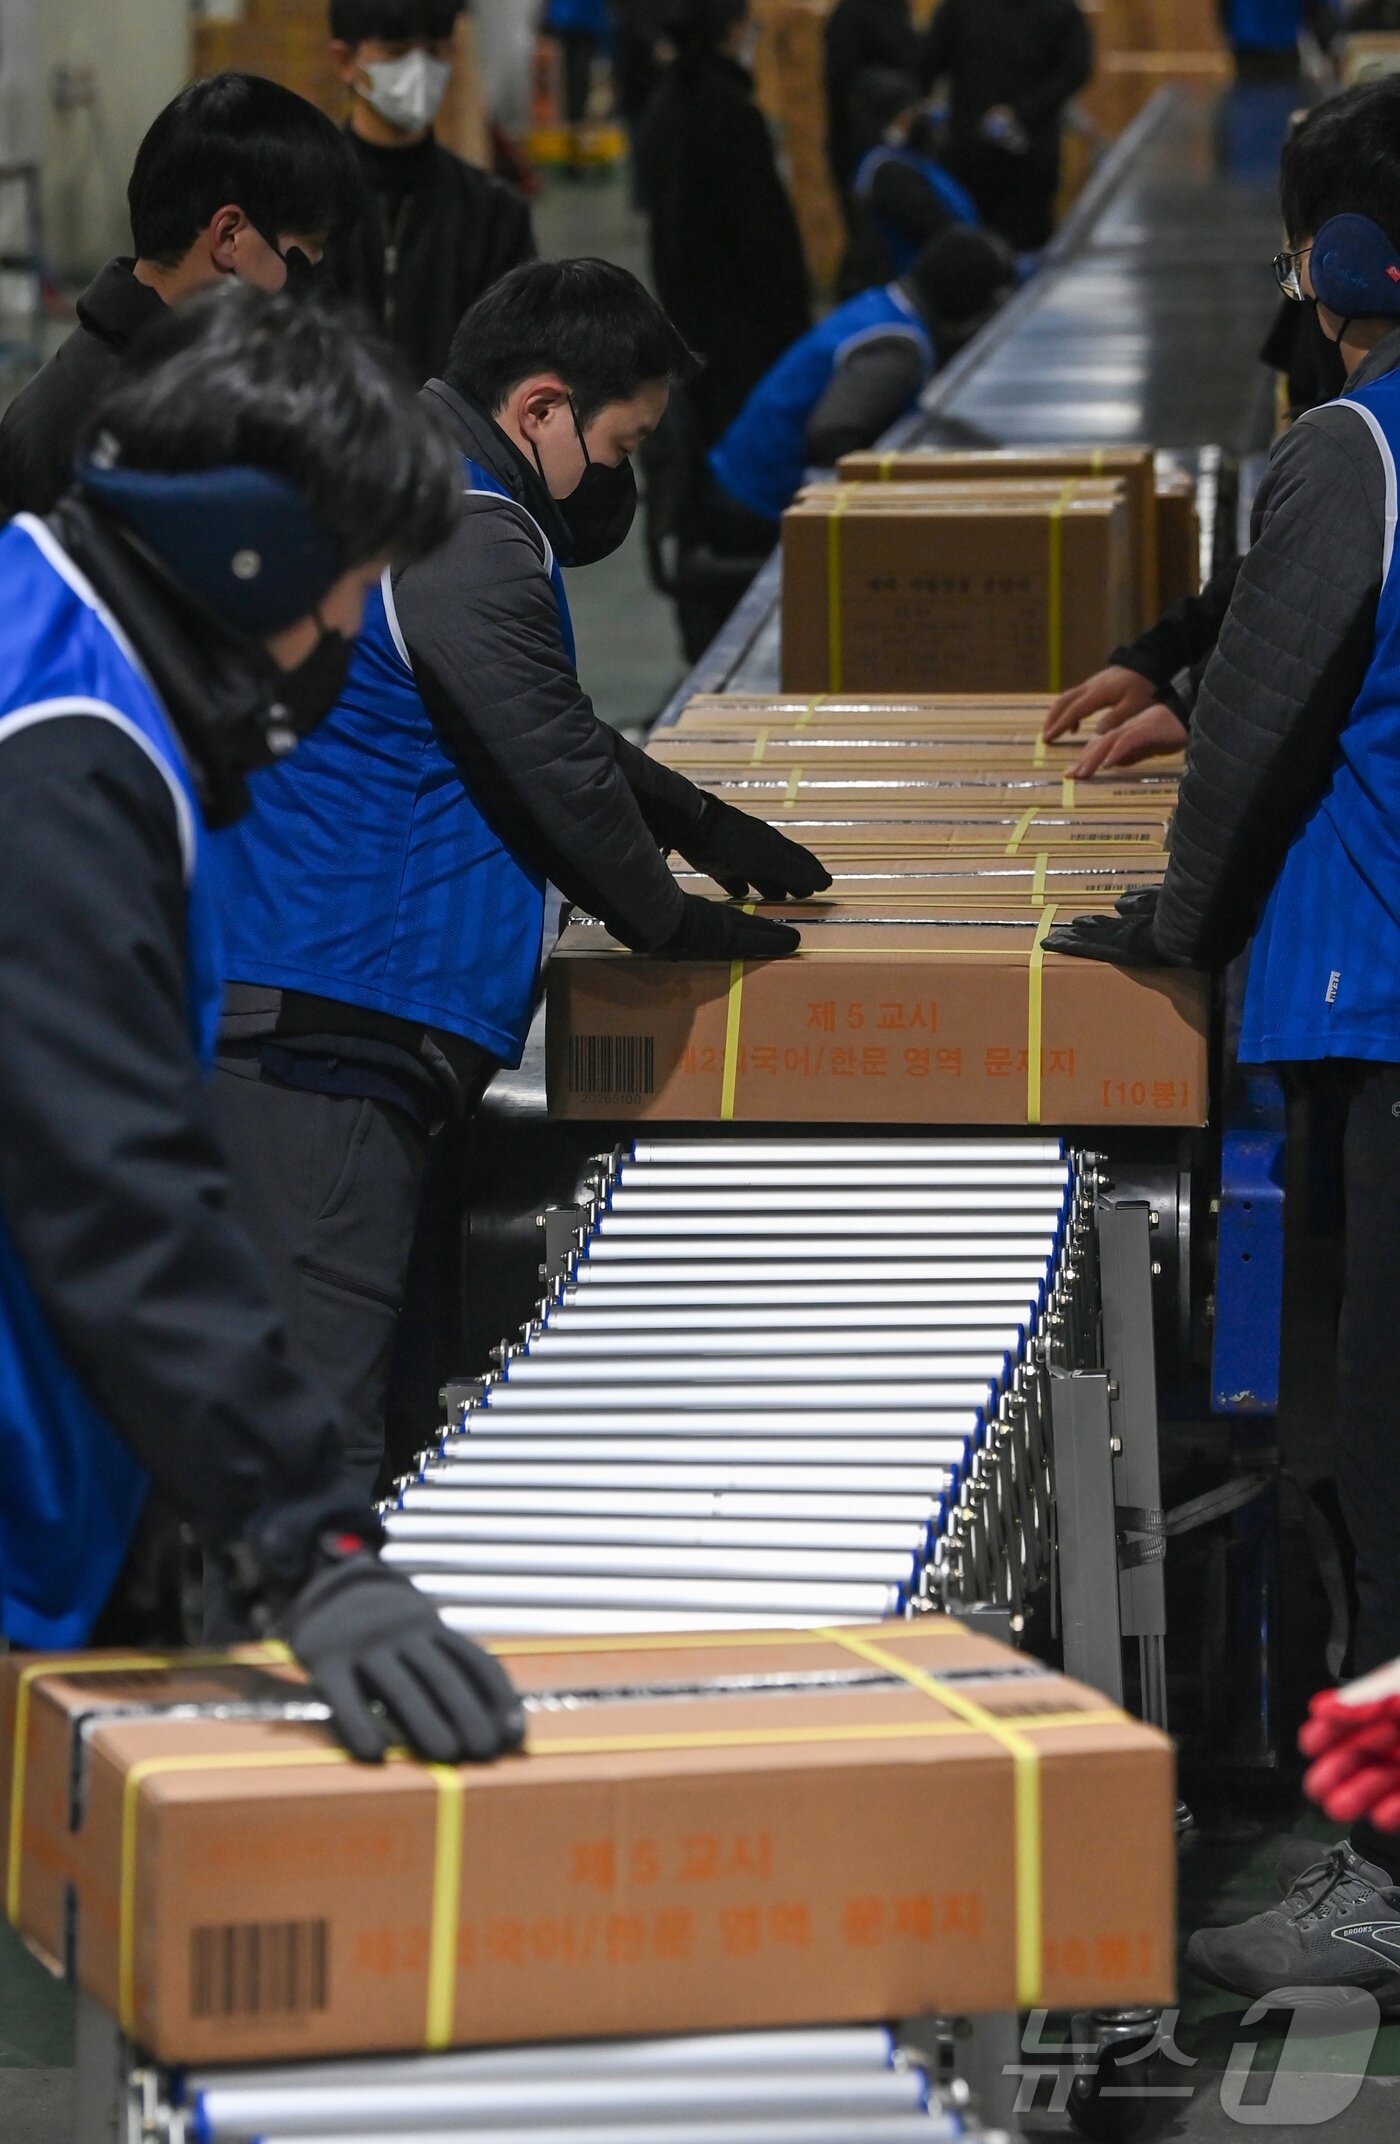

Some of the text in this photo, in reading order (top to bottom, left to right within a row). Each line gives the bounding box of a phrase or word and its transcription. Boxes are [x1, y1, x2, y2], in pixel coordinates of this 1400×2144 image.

[806, 1001, 938, 1033] 제 5 교시
[672, 1045, 888, 1076] 제2국어/한문
[904, 1047, 962, 1077] 영역
[1343, 1926, 1373, 1937] BROOKS
